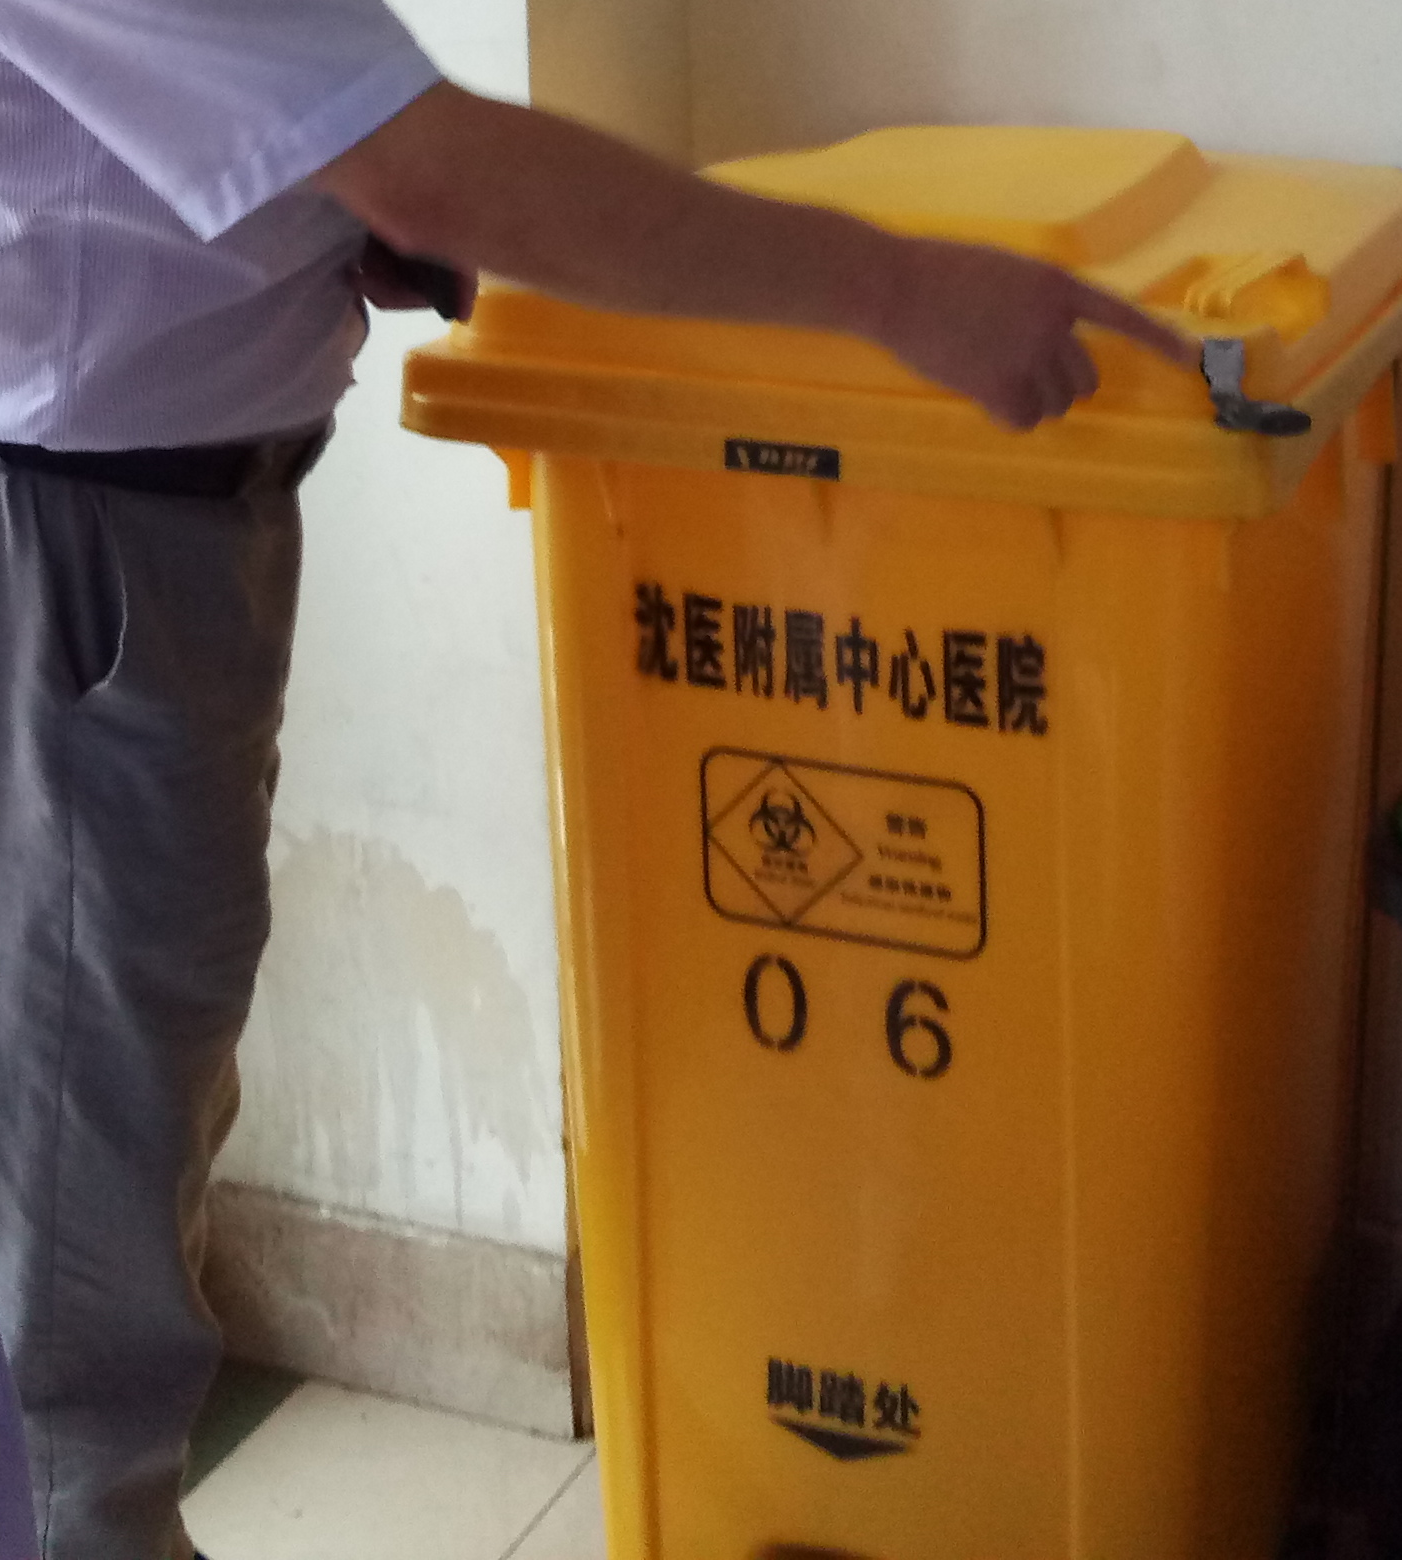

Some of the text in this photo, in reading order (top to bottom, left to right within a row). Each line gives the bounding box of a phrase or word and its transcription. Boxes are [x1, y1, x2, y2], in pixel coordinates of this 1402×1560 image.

[634, 581, 1049, 736] 沈医附属中心医院
[766, 1355, 922, 1438] 脚踏处
